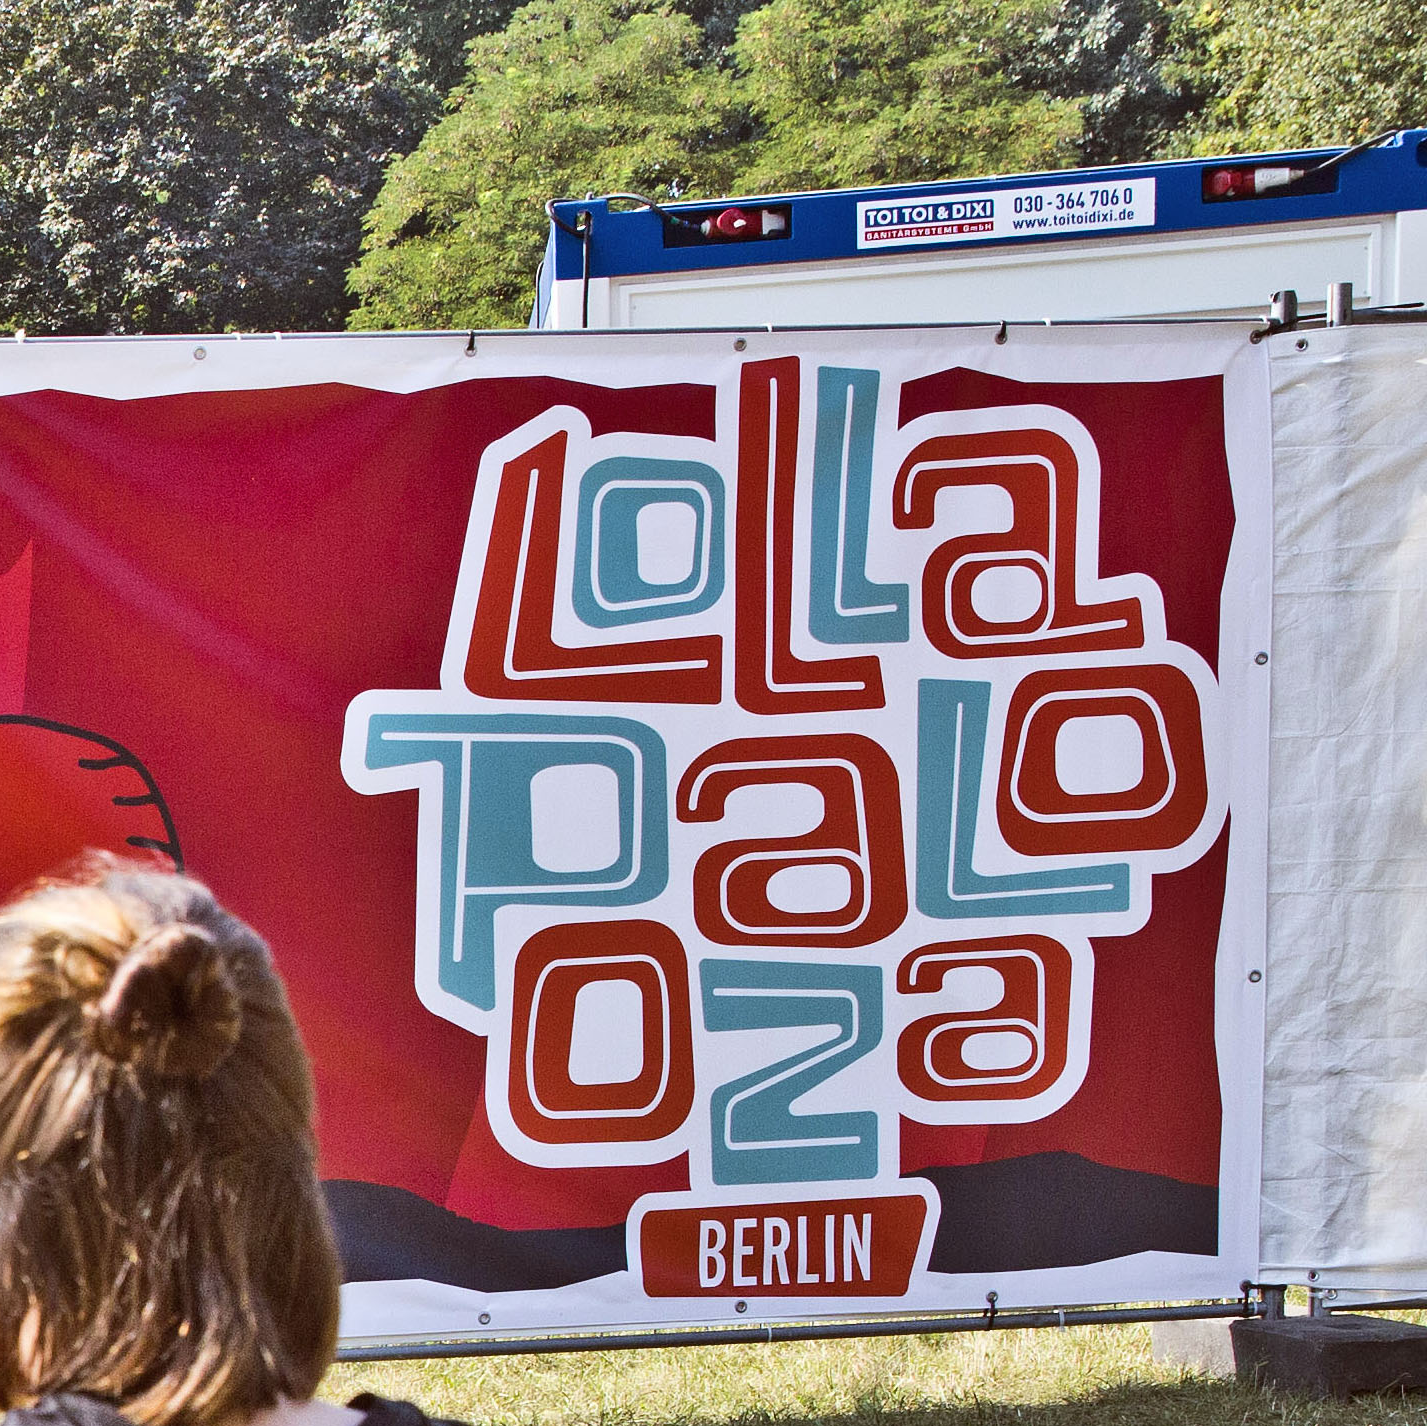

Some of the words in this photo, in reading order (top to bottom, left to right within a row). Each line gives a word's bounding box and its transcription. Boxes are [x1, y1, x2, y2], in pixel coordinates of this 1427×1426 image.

[1014, 195, 1043, 213] 030
[1056, 192, 1085, 210] 364
[867, 209, 898, 226] TOI
[902, 206, 933, 222] TOI
[937, 206, 948, 220] &
[952, 201, 991, 219] DIXI
[1013, 208, 1134, 229] www.toitoidixi.de
[963, 223, 992, 233] GmbH
[698, 1213, 872, 1288] BERLIN
